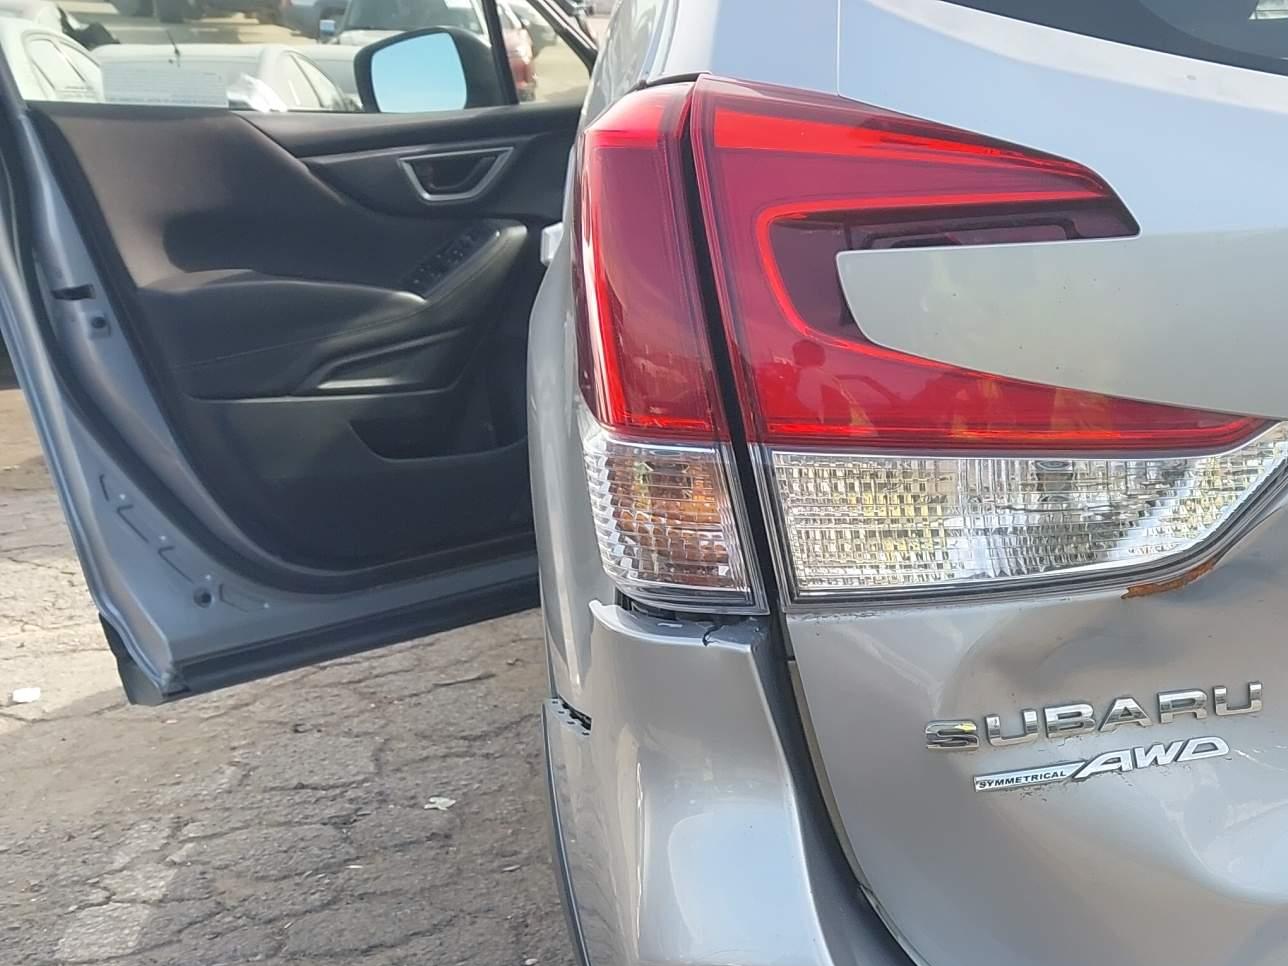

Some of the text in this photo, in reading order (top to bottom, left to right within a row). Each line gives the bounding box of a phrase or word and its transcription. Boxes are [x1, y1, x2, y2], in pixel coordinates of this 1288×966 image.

[925, 680, 1263, 750] SUBARU
[978, 735, 1231, 789] SYMMETRICAL AWD
